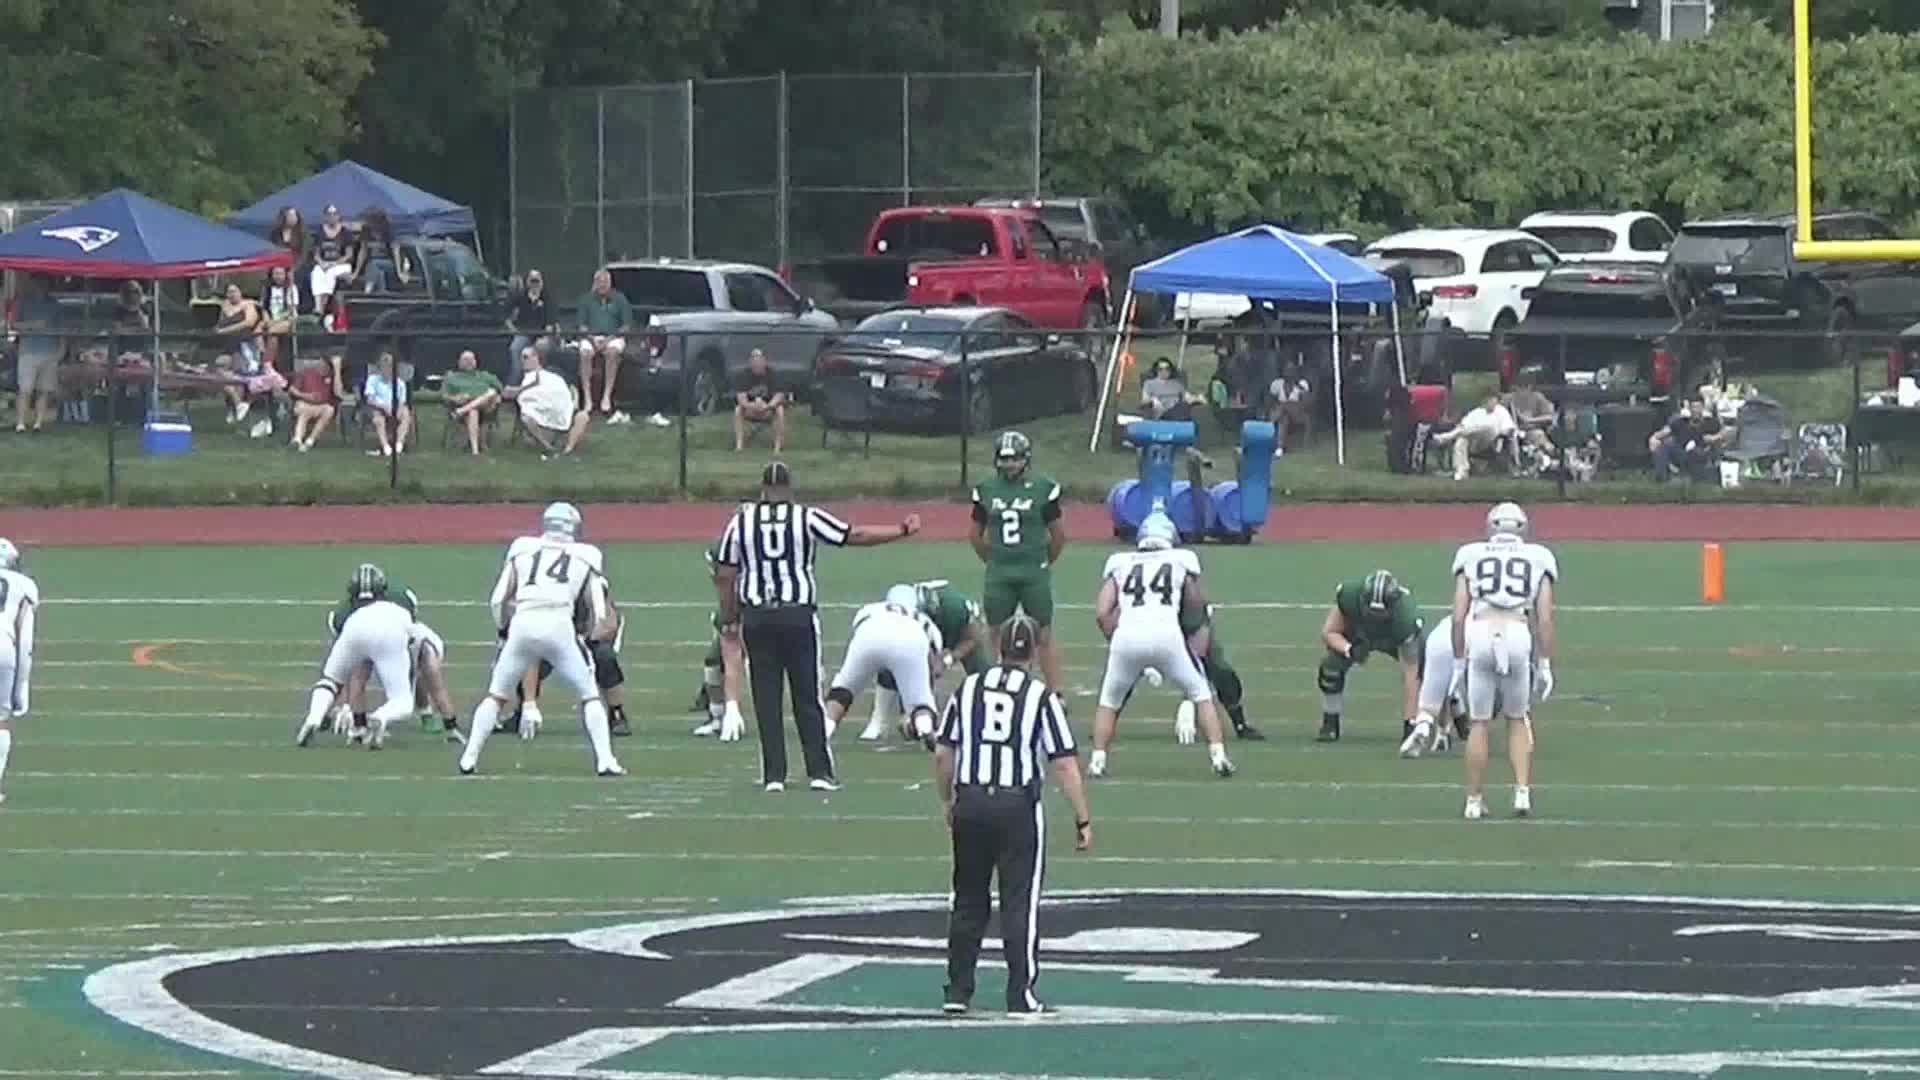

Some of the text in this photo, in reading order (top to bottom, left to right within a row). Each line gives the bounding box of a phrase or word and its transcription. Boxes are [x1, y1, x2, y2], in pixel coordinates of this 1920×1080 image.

[760, 523, 786, 558] U
[1001, 510, 1020, 544] 2
[525, 549, 571, 586] 14
[1123, 562, 1173, 608] 44
[1476, 557, 1532, 598] 99
[982, 689, 1015, 742] B
